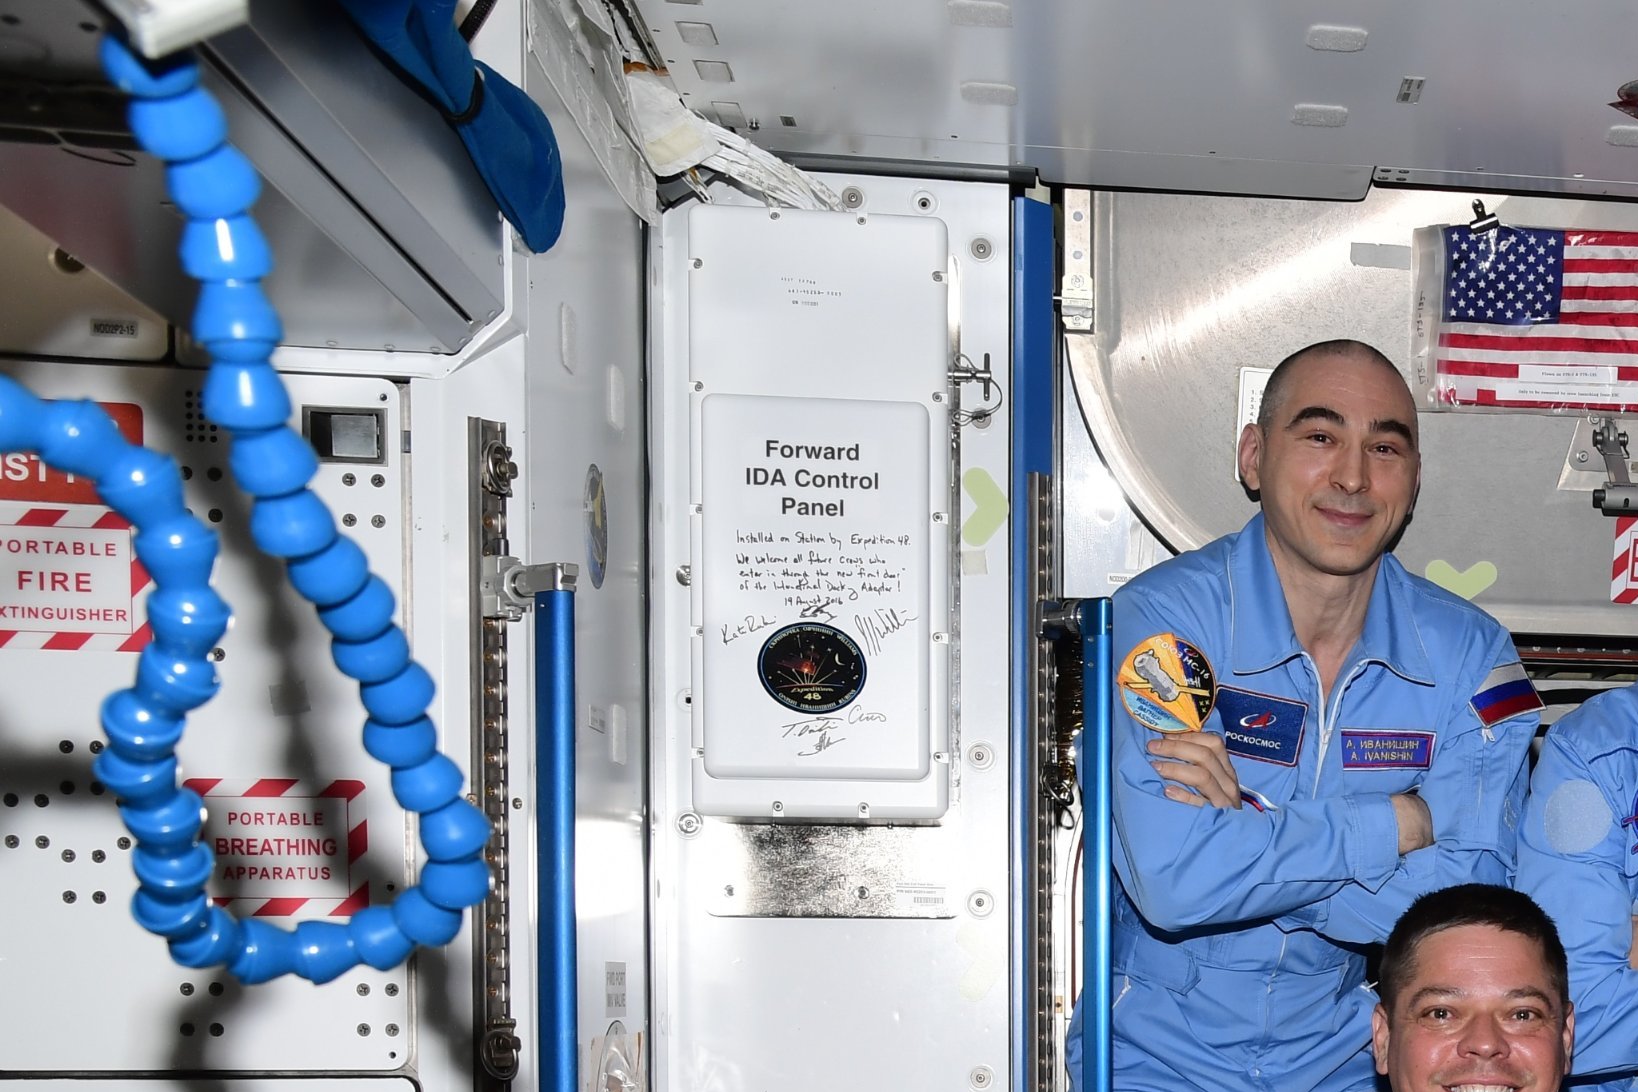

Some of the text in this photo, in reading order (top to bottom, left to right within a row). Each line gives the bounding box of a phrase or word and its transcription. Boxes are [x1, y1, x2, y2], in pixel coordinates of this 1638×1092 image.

[766, 440, 860, 461] Forward
[0, 452, 46, 482] ST
[746, 467, 879, 490] IDA Control
[782, 497, 844, 517] Panel
[0, 539, 117, 557] ORTABLE
[736, 529, 774, 544] Installed
[829, 532, 842, 551] by
[850, 533, 895, 551] Expedition
[736, 553, 750, 565] We
[17, 570, 93, 593] FIRE
[784, 597, 793, 606] 19
[803, 692, 822, 701] 48
[1225, 730, 1282, 750] РОСКОСМОС
[1360, 739, 1420, 750] ИВАНИШИН
[1364, 751, 1414, 762] IVANISHIN
[227, 812, 325, 826] PORTABLE
[215, 837, 338, 857] BREATHING
[222, 866, 332, 881] APPARATUS
